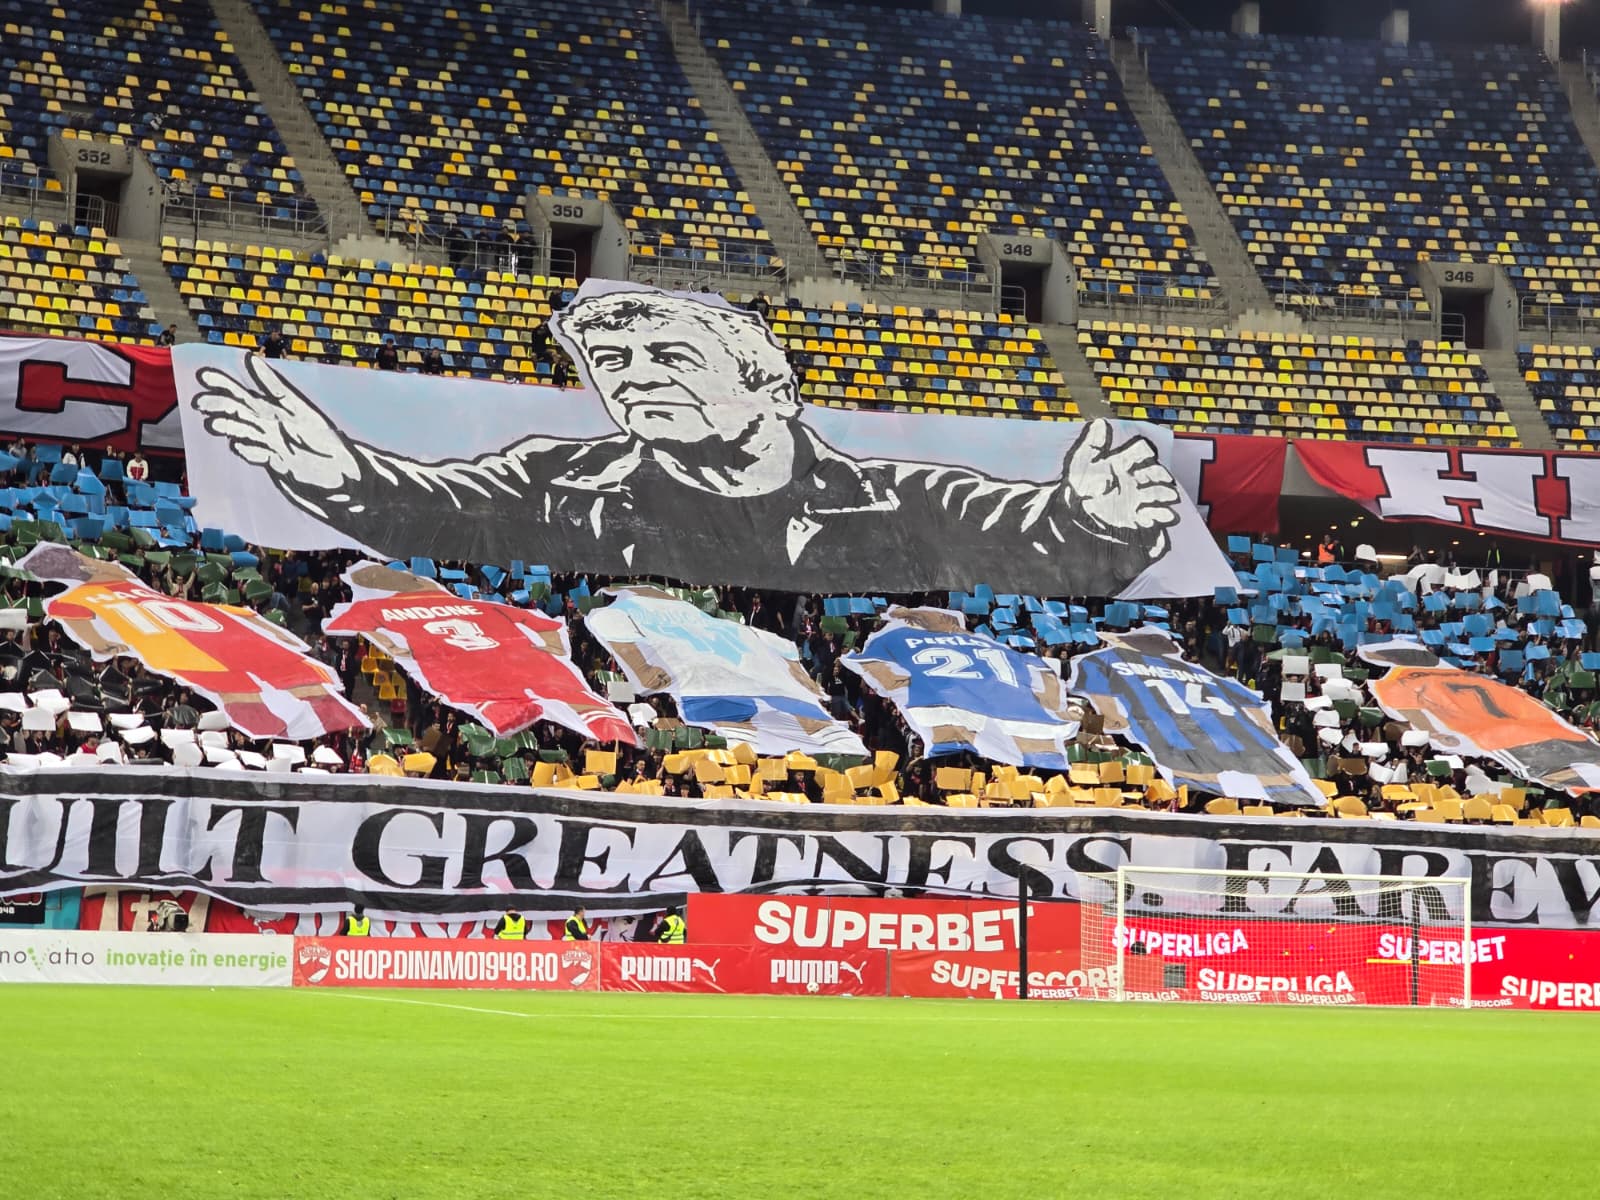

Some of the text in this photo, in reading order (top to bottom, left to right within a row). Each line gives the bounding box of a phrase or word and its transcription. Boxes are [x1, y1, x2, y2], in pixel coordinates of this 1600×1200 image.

[78, 149, 111, 165] 352
[552, 204, 584, 218] 350
[1003, 243, 1033, 257] 348
[1444, 270, 1474, 283] 346
[102, 600, 224, 634] 10
[380, 605, 484, 622] ANDONE
[423, 618, 500, 650] 3
[911, 647, 1019, 688] 21
[753, 900, 1035, 952] SUPERBET
[106, 948, 185, 972] inovație
[189, 948, 208, 967] în
[213, 951, 287, 971] energie
[335, 949, 559, 982] SHOP.DINAMO1948.RO
[621, 956, 692, 982] PUMA
[770, 959, 839, 984] PUMA
